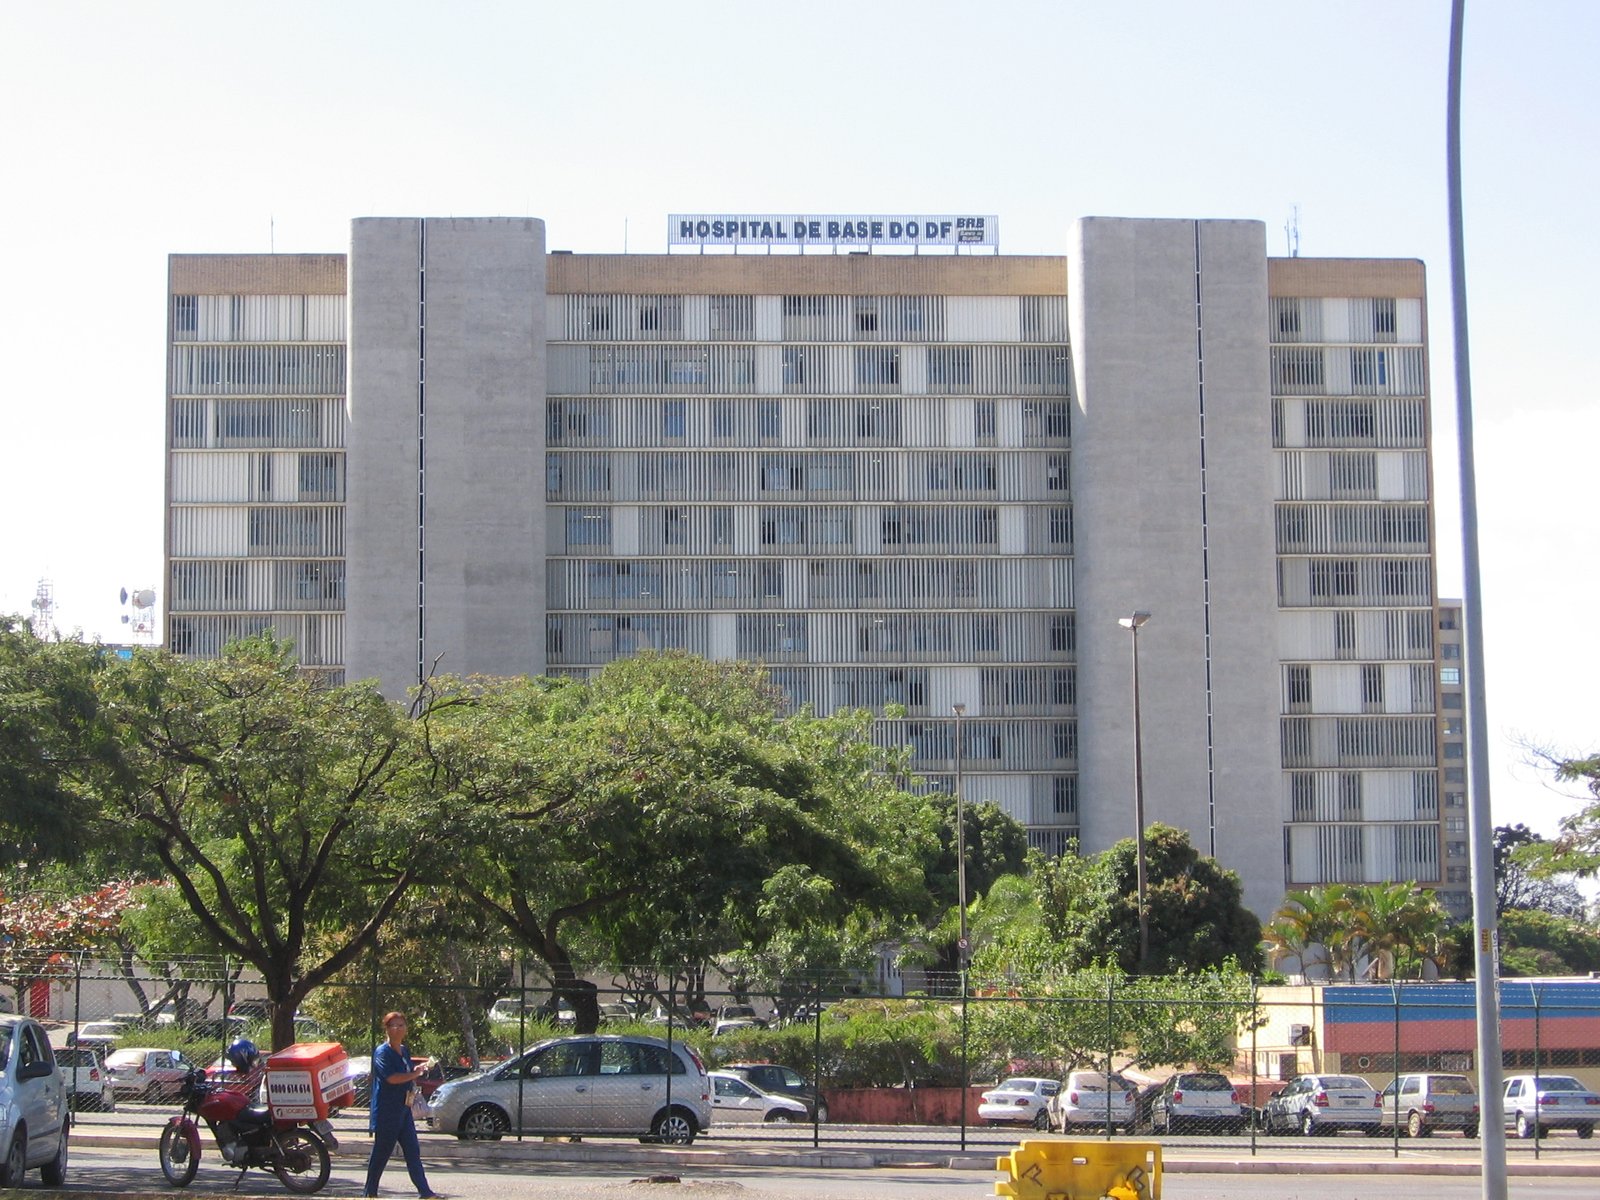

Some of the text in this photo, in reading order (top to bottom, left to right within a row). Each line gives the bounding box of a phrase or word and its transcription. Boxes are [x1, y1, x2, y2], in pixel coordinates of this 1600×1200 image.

[680, 220, 952, 239] HOSPITAL DE BASE DO DF
[956, 217, 985, 229] BRB
